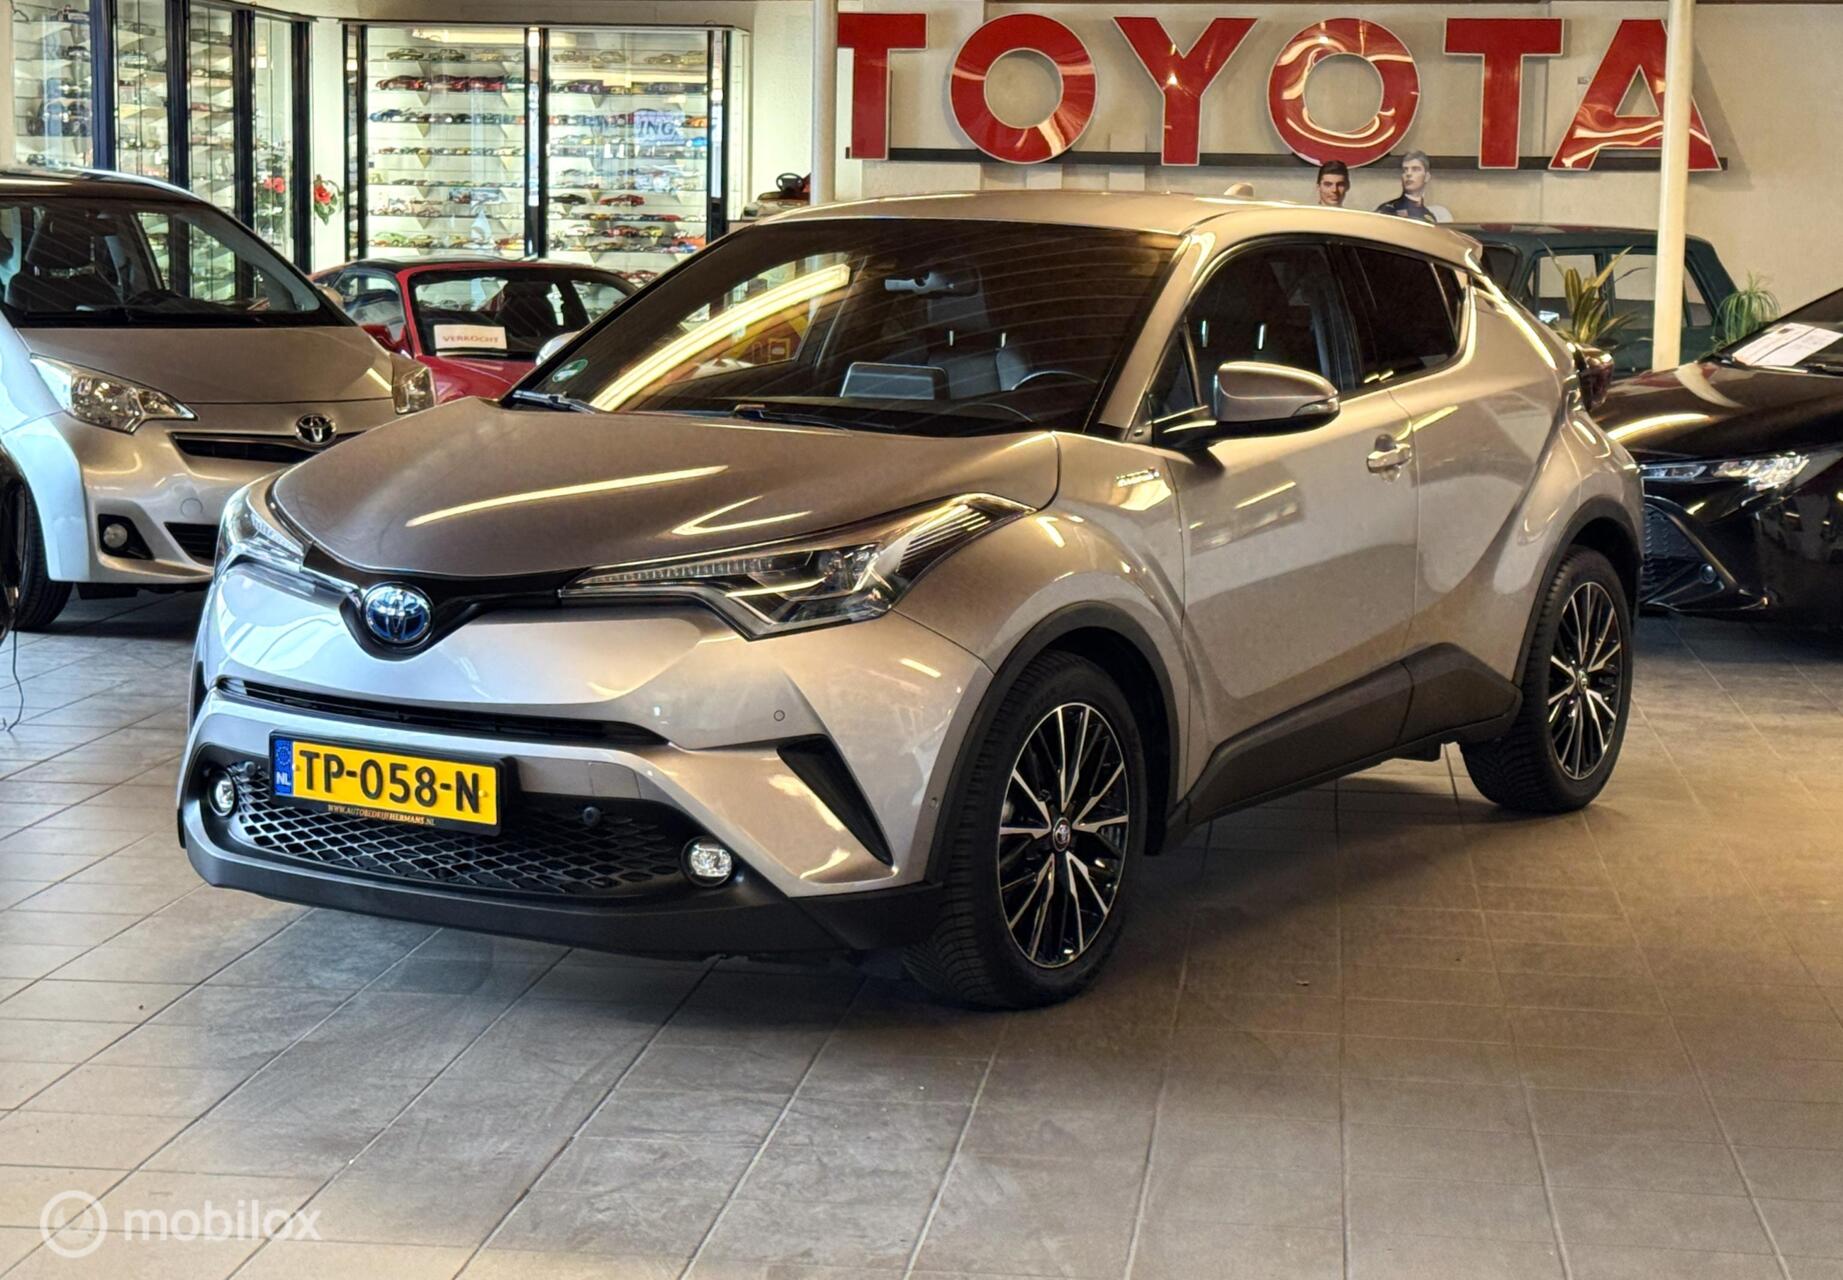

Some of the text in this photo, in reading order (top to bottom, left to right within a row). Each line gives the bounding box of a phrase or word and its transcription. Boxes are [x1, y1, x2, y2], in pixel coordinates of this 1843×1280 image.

[837, 13, 1722, 171] TOYOTA
[442, 335, 499, 343] VERKOCHT
[275, 771, 292, 786] NL
[299, 750, 480, 813] TP-058-N
